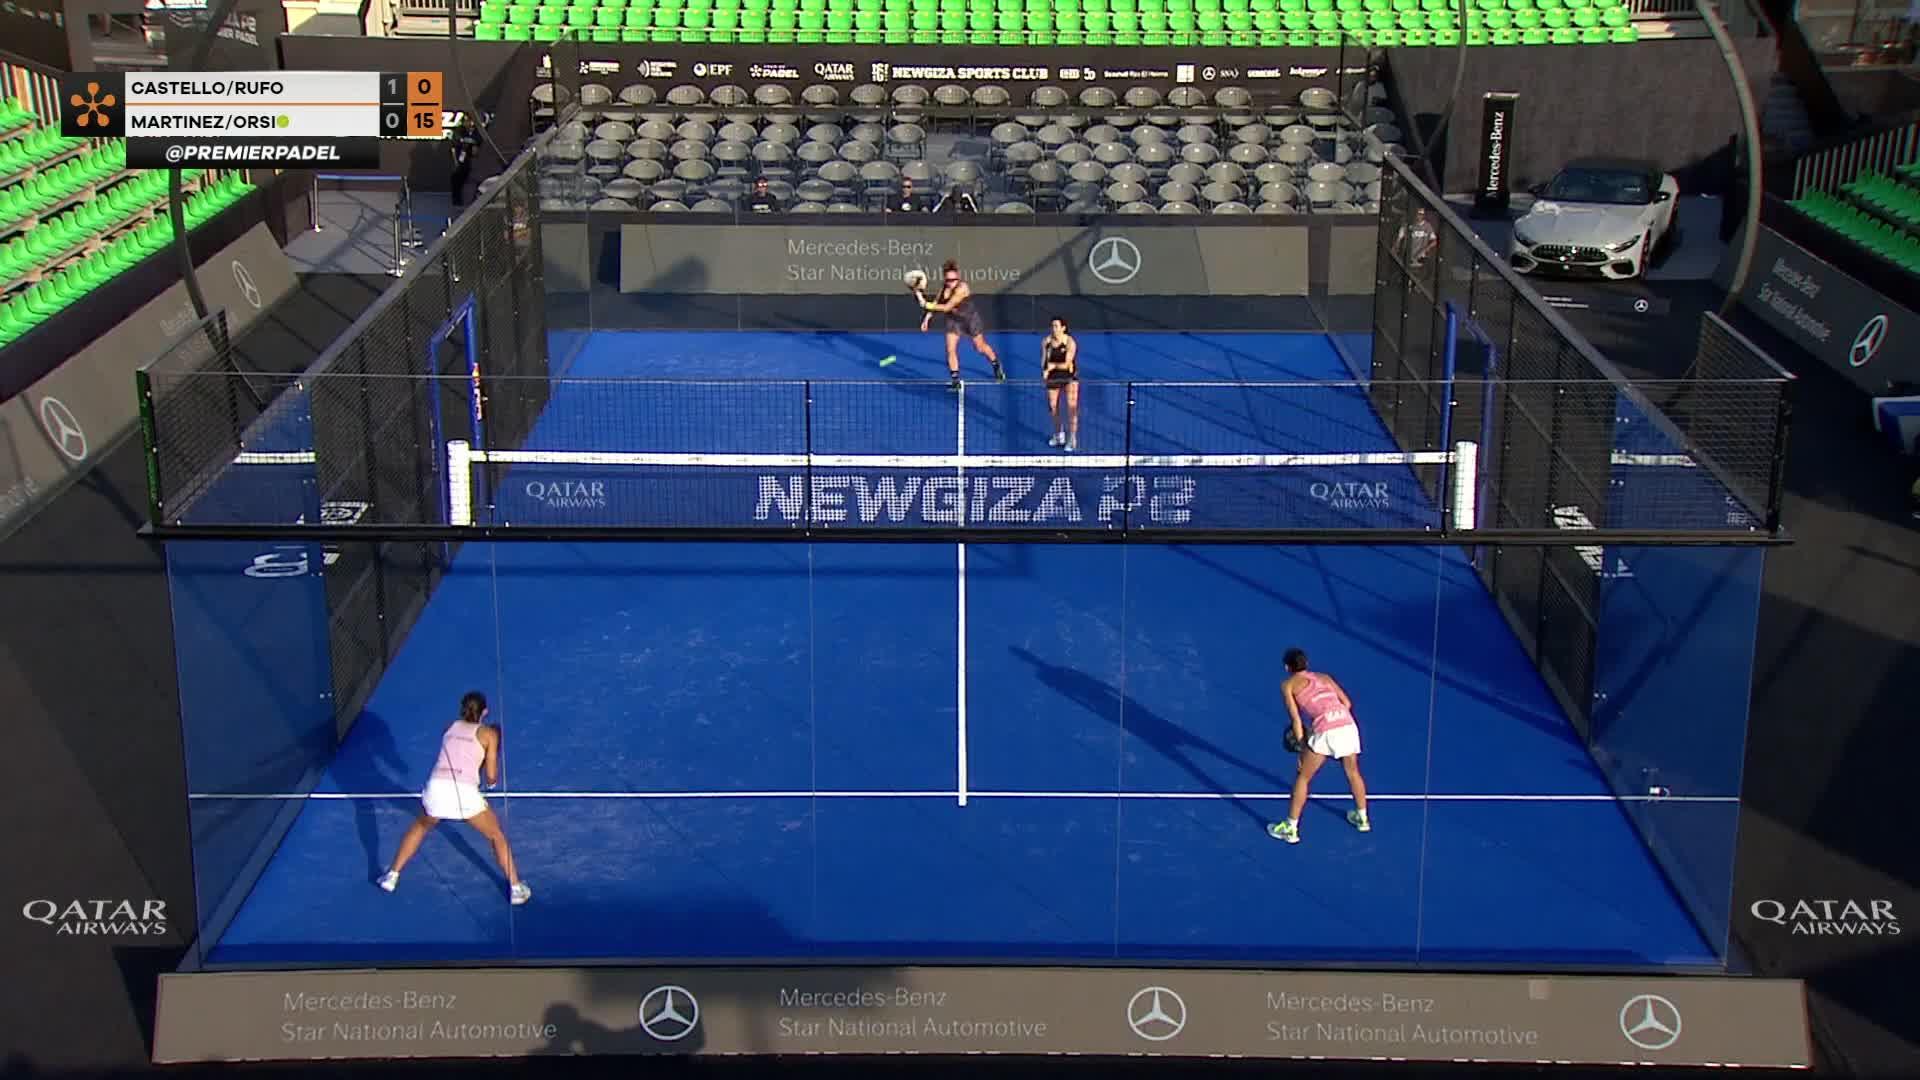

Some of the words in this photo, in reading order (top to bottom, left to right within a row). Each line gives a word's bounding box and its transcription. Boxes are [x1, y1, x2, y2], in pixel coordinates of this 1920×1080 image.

[709, 64, 733, 76] EPF
[814, 63, 854, 76] QATAR
[892, 67, 955, 79] NEWGIZA
[957, 68, 1010, 80] SPORTS
[1012, 68, 1048, 80] CLUB
[787, 239, 934, 256] Mercedes-Benz
[787, 264, 825, 281] Star
[525, 481, 605, 501] QATAR
[754, 475, 1083, 524] NEWGIZA
[1309, 481, 1389, 501] QATAR
[547, 498, 606, 509] AIRWAYS
[1331, 498, 1390, 509] AIRWAYS
[22, 899, 167, 924] QATAR
[1750, 899, 1897, 923] QATAR
[56, 921, 167, 936] AIRWAYS
[1792, 921, 1901, 936] AIRWAYS
[283, 990, 457, 1011] Mercedes-Benz
[780, 987, 946, 1008] Mercedes-Benz
[1267, 991, 1435, 1013] Mercedes-Benz
[281, 1021, 326, 1042] Star
[332, 1021, 424, 1041] National
[429, 1020, 558, 1040] Automotive
[778, 1017, 820, 1038] Star
[827, 1017, 917, 1037] National
[923, 1017, 1047, 1038] Automotive
[1266, 1021, 1310, 1042] Star
[1316, 1022, 1406, 1044] National
[1411, 1023, 1538, 1046] Automotive
